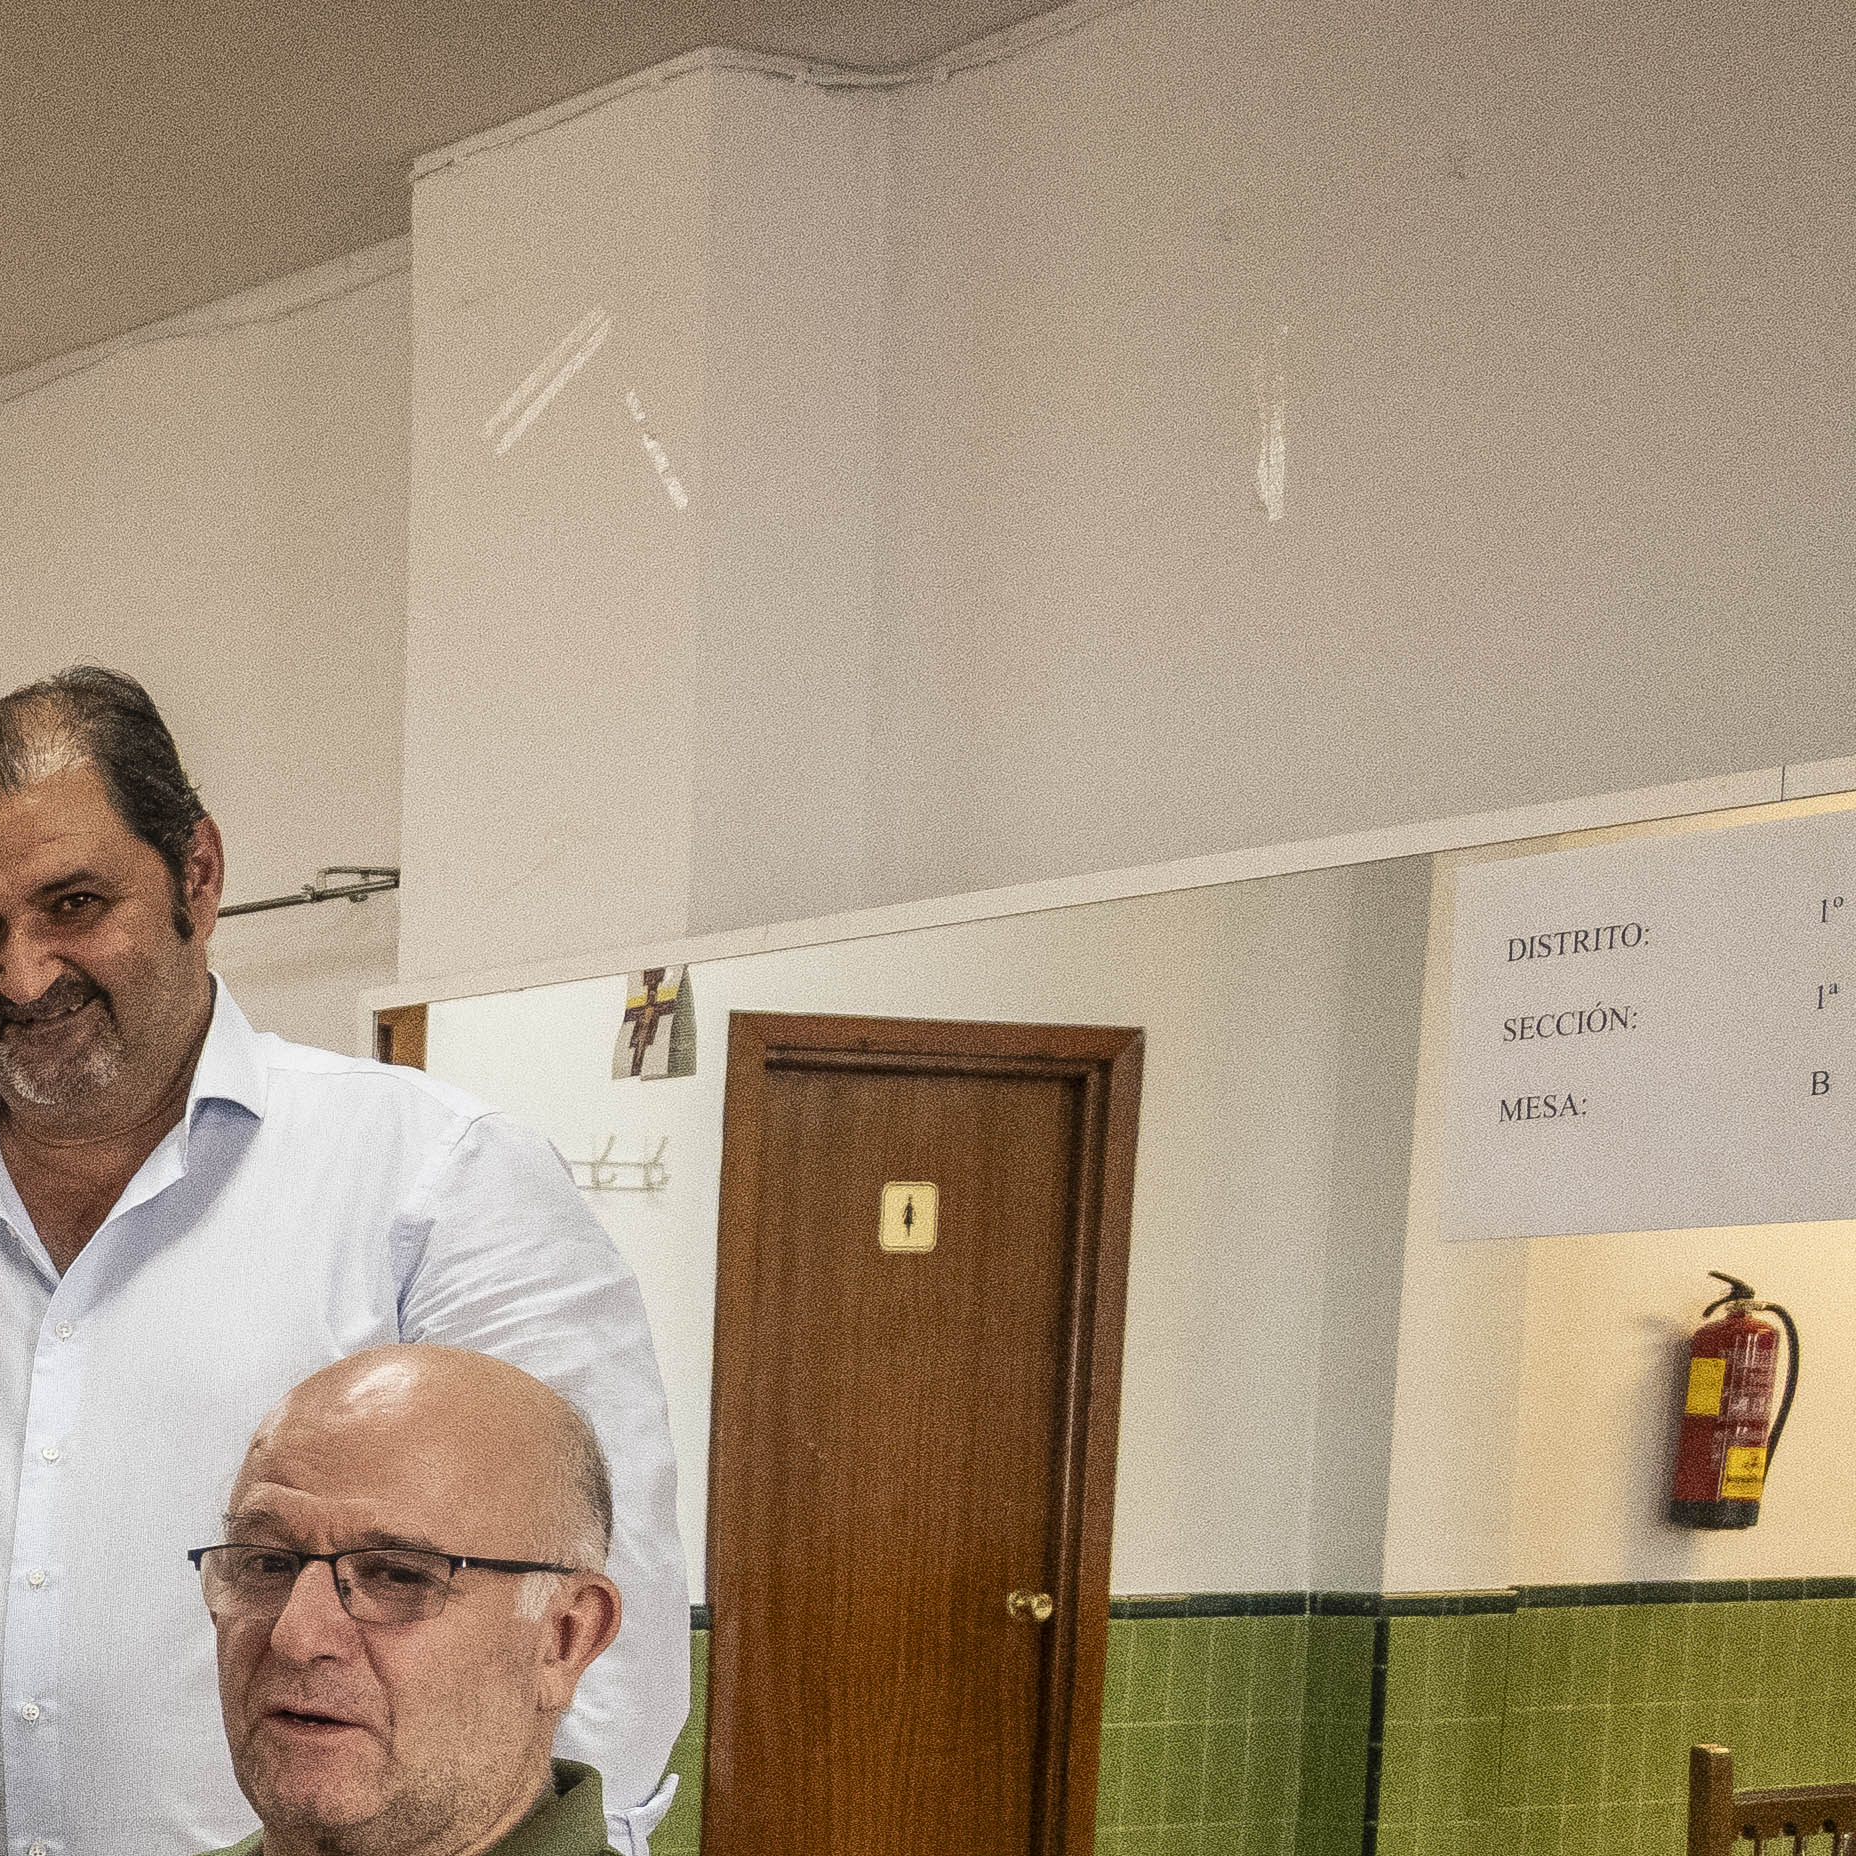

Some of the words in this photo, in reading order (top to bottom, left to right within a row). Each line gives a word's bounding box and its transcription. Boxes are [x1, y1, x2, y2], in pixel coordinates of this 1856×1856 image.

[1507, 922, 1650, 962] DISTRITO:
[1503, 1002, 1637, 1041] SECCIÓN:
[1499, 1093, 1587, 1122] MESA:
[1811, 1071, 1830, 1096] B
